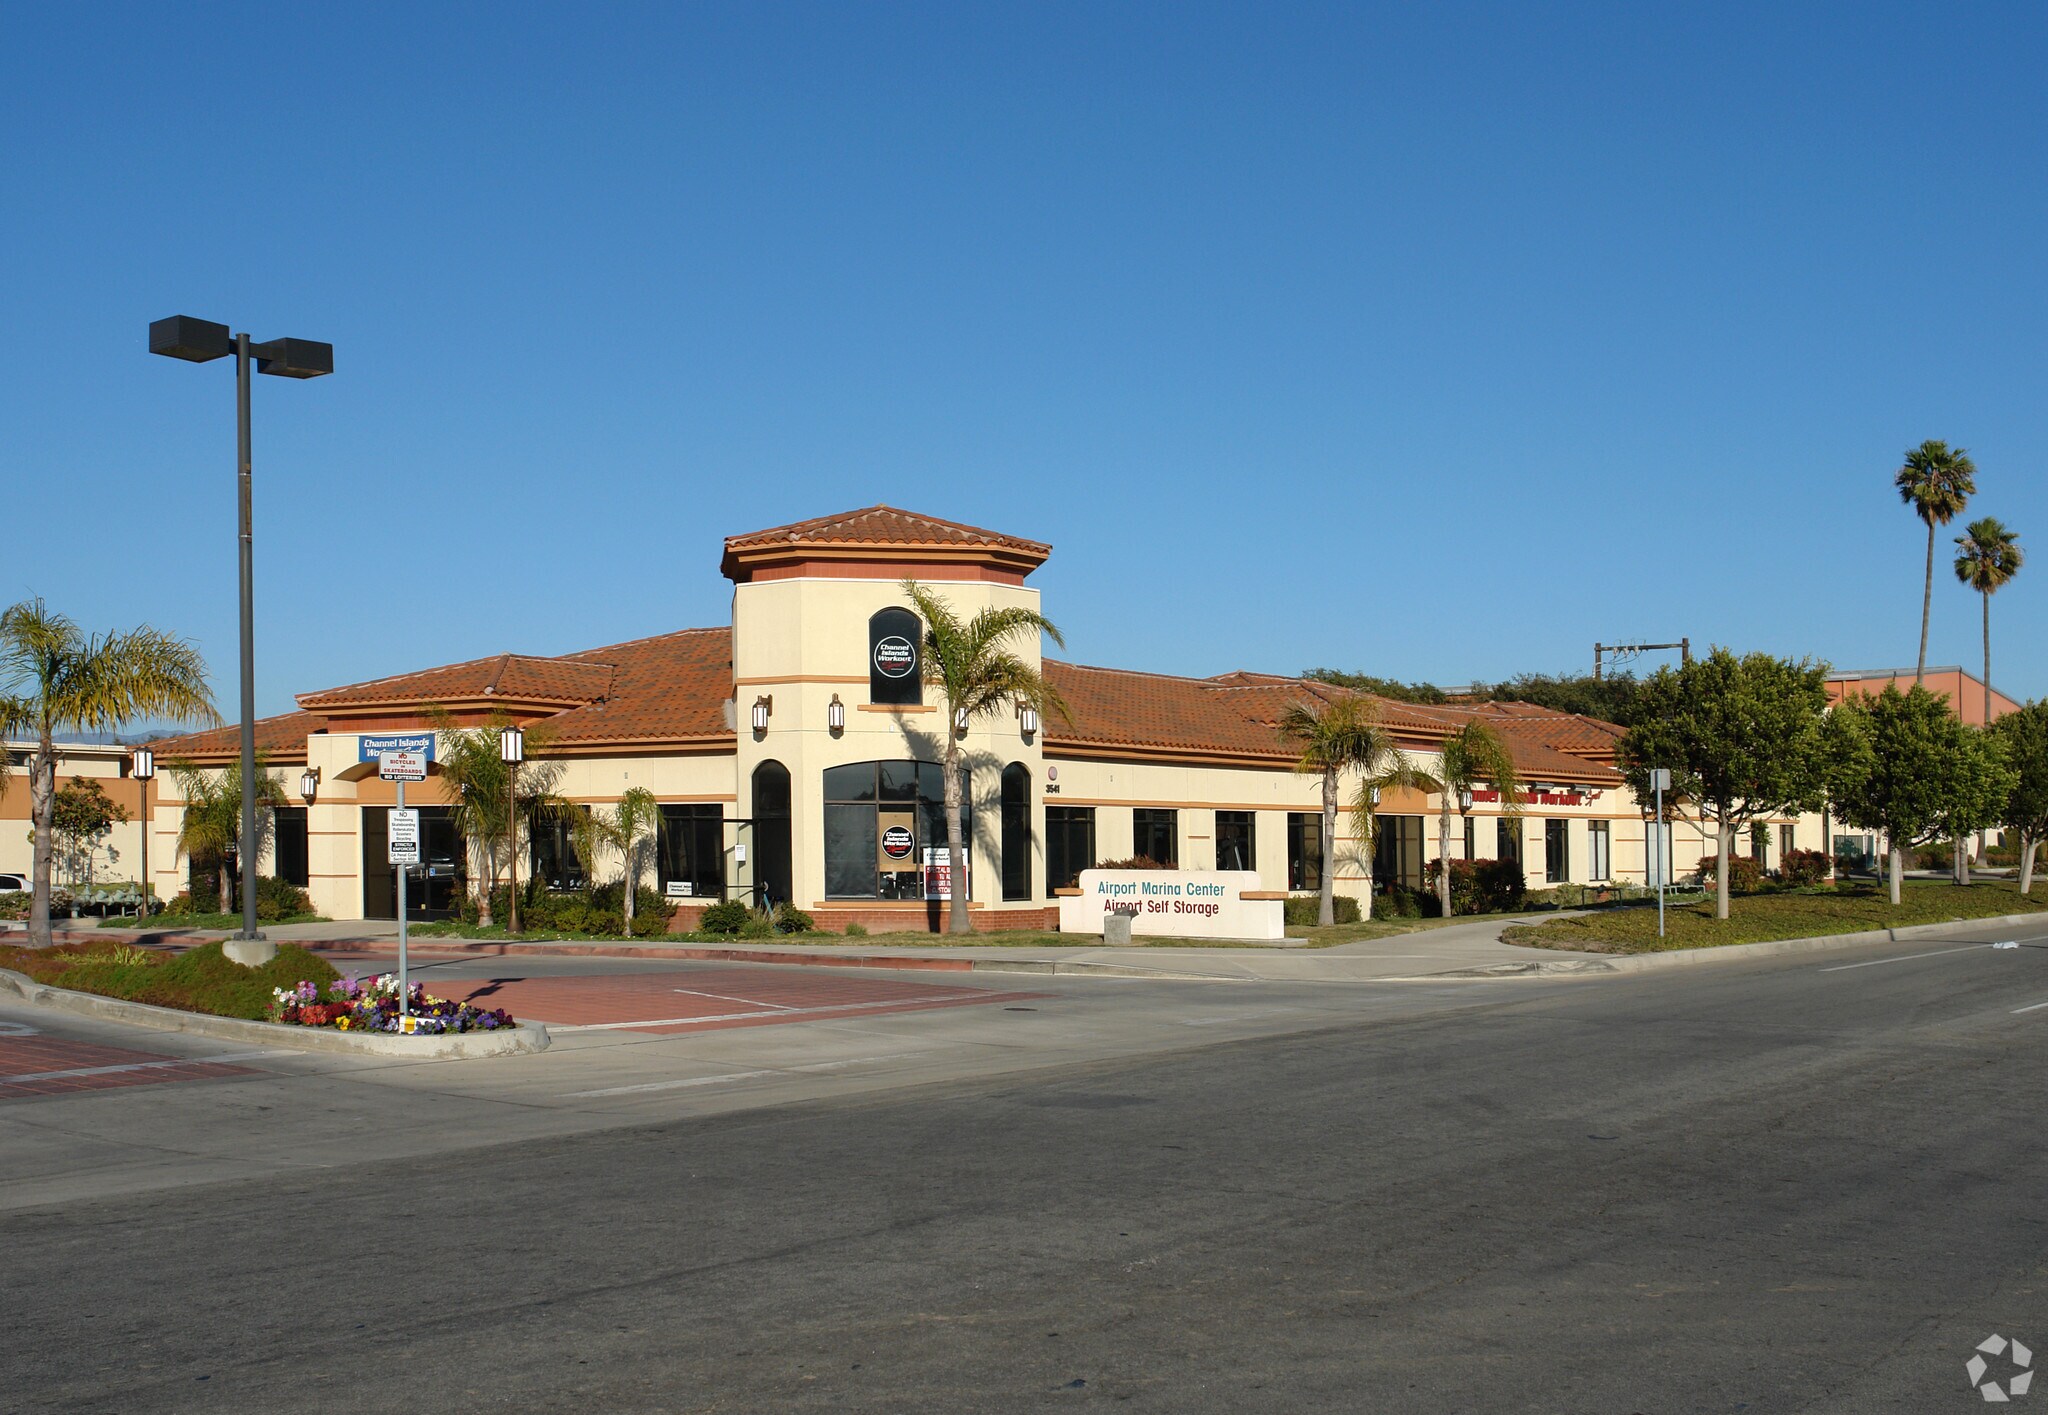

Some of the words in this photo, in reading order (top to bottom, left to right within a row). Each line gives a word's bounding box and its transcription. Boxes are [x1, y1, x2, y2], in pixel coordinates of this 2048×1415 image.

[364, 739, 398, 748] Channel
[399, 738, 430, 747] Islands
[1046, 784, 1060, 793] 3541
[1098, 881, 1136, 897] Airport
[1142, 882, 1180, 896] Marina
[1186, 882, 1225, 896] Center
[1148, 900, 1169, 913] Self
[1174, 900, 1219, 918] Storage
